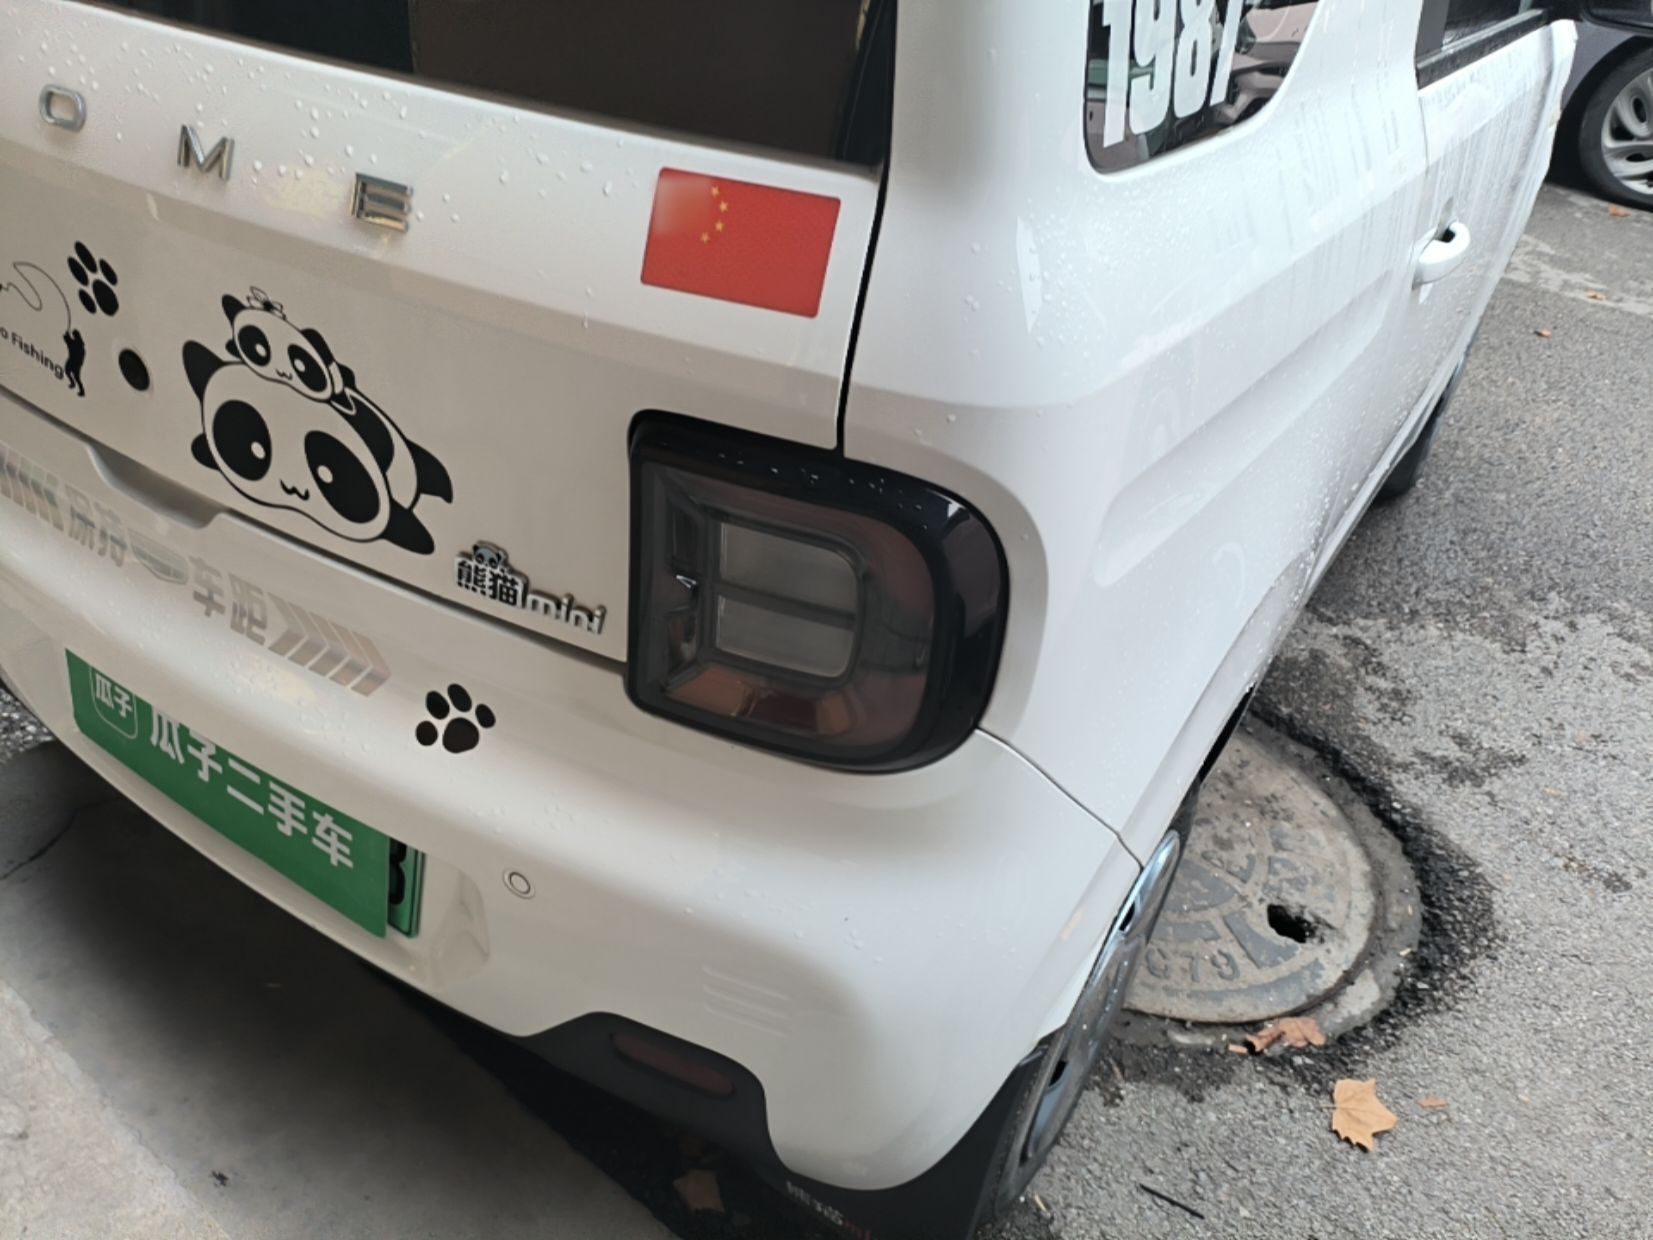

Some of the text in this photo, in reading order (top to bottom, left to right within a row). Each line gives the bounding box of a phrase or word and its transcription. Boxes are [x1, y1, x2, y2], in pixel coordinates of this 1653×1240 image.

[11, 331, 64, 380] Fishing
[95, 673, 133, 718] 瓜子
[151, 706, 354, 869] 瓜子二手车
